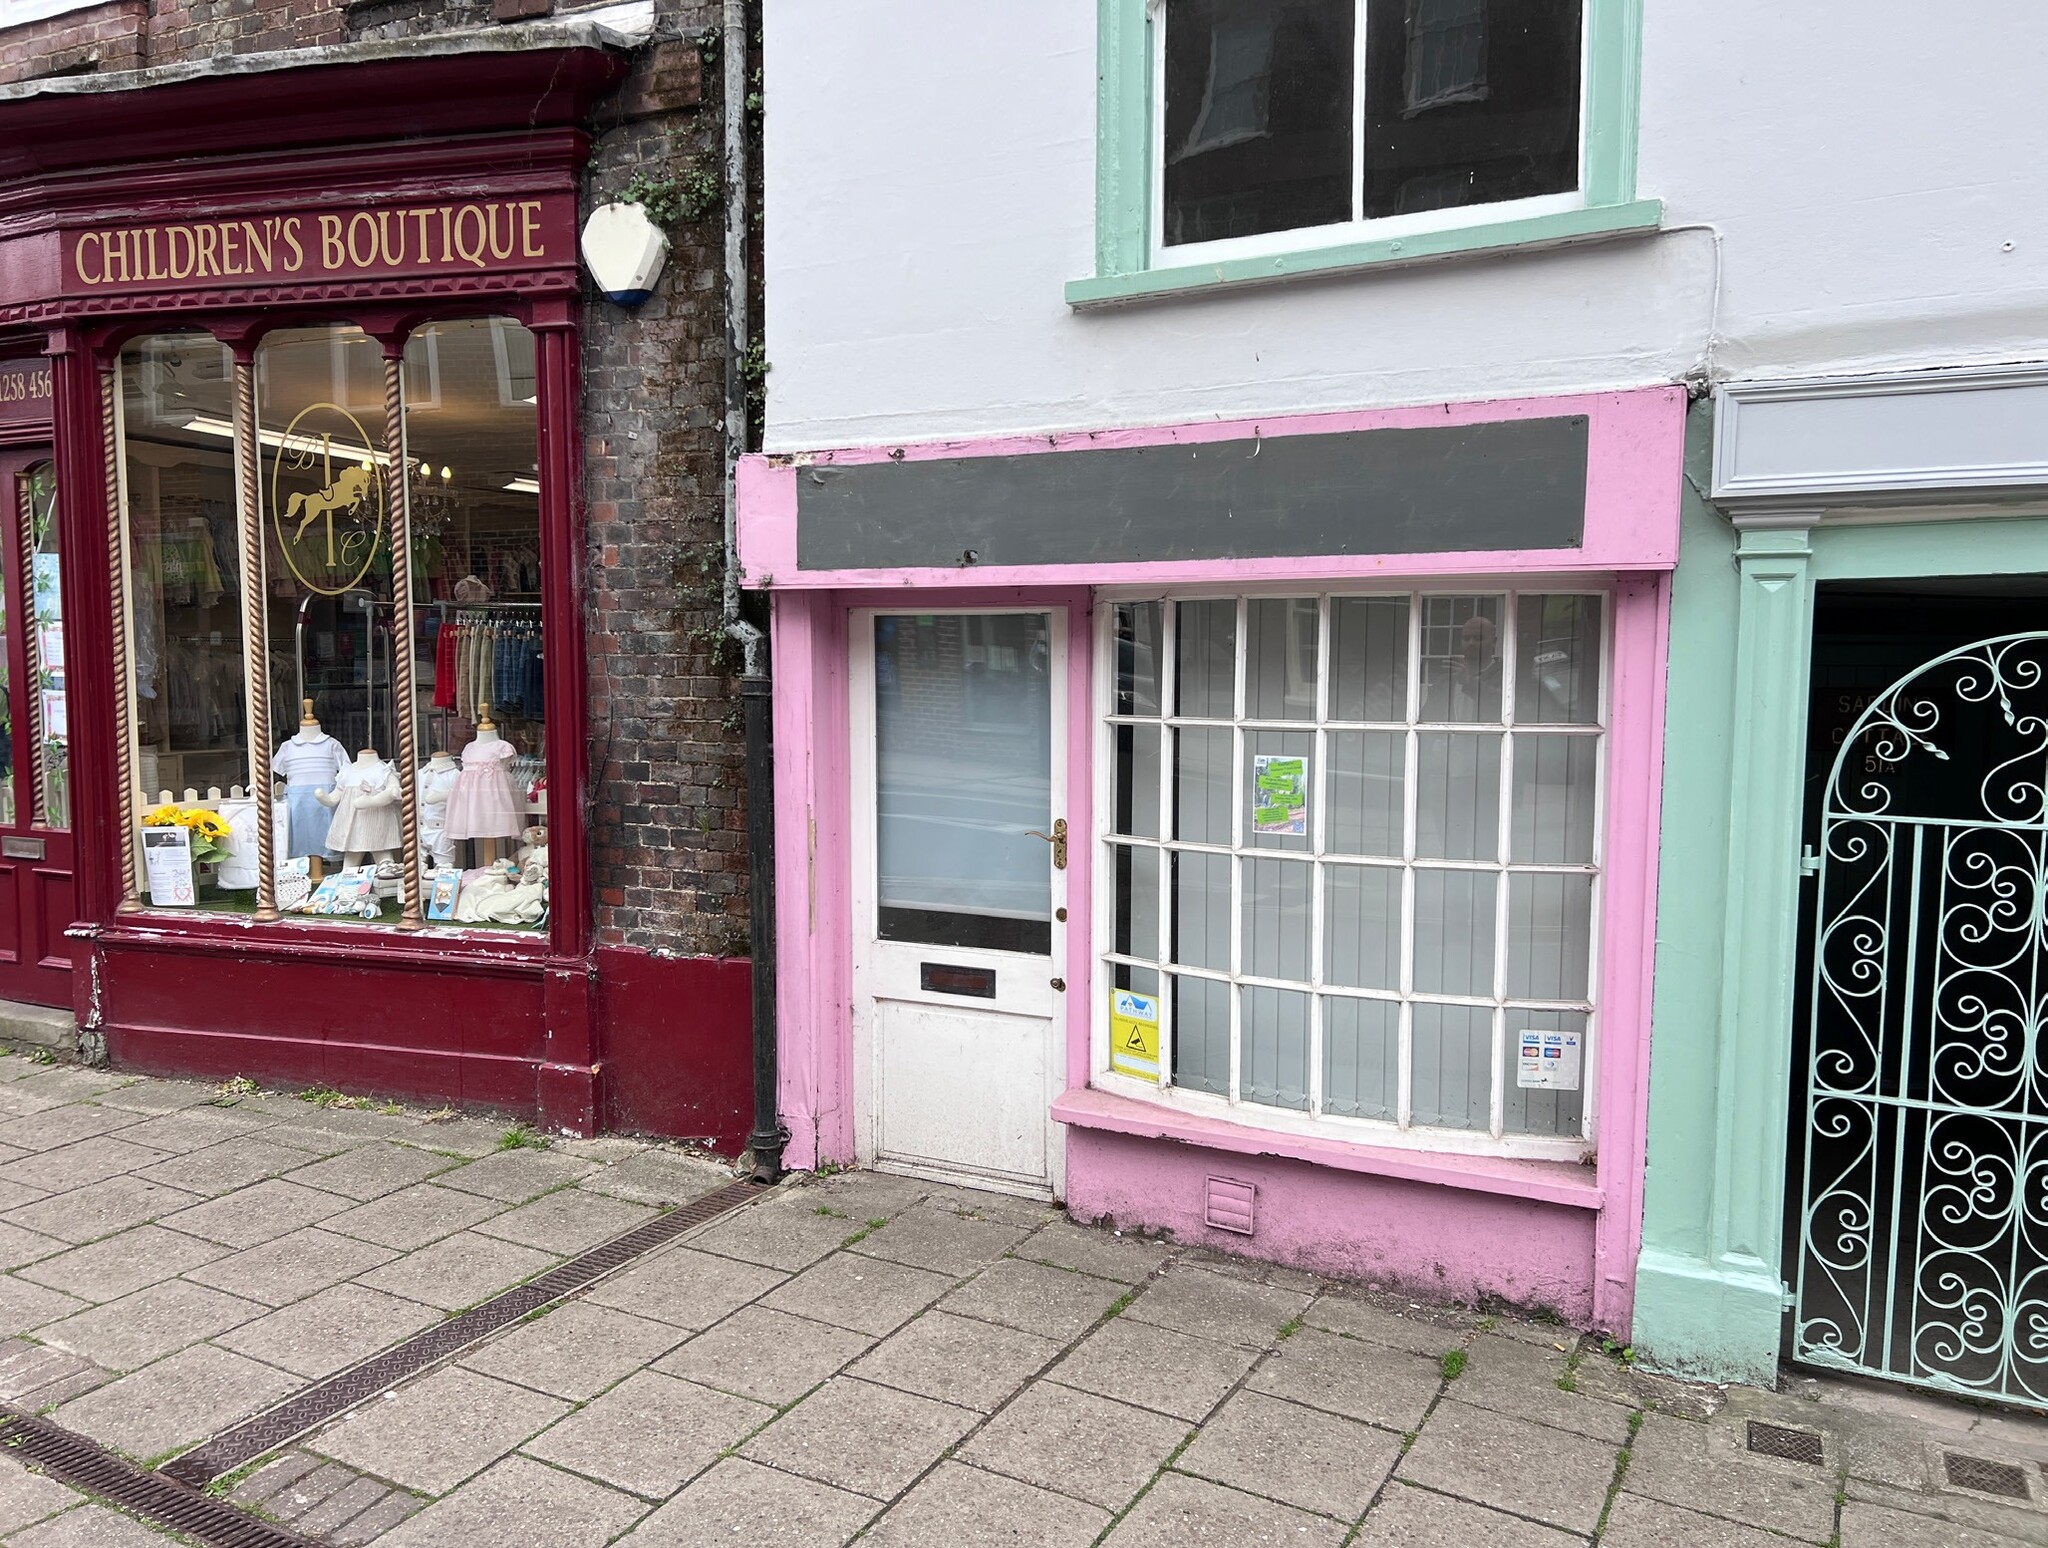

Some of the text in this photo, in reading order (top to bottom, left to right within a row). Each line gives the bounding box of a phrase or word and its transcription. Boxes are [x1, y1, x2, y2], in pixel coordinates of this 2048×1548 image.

[75, 200, 545, 285] CHILDREN'S BOUTIQUE
[29, 369, 53, 399] 456
[1120, 1006, 1152, 1017] PATHWAY
